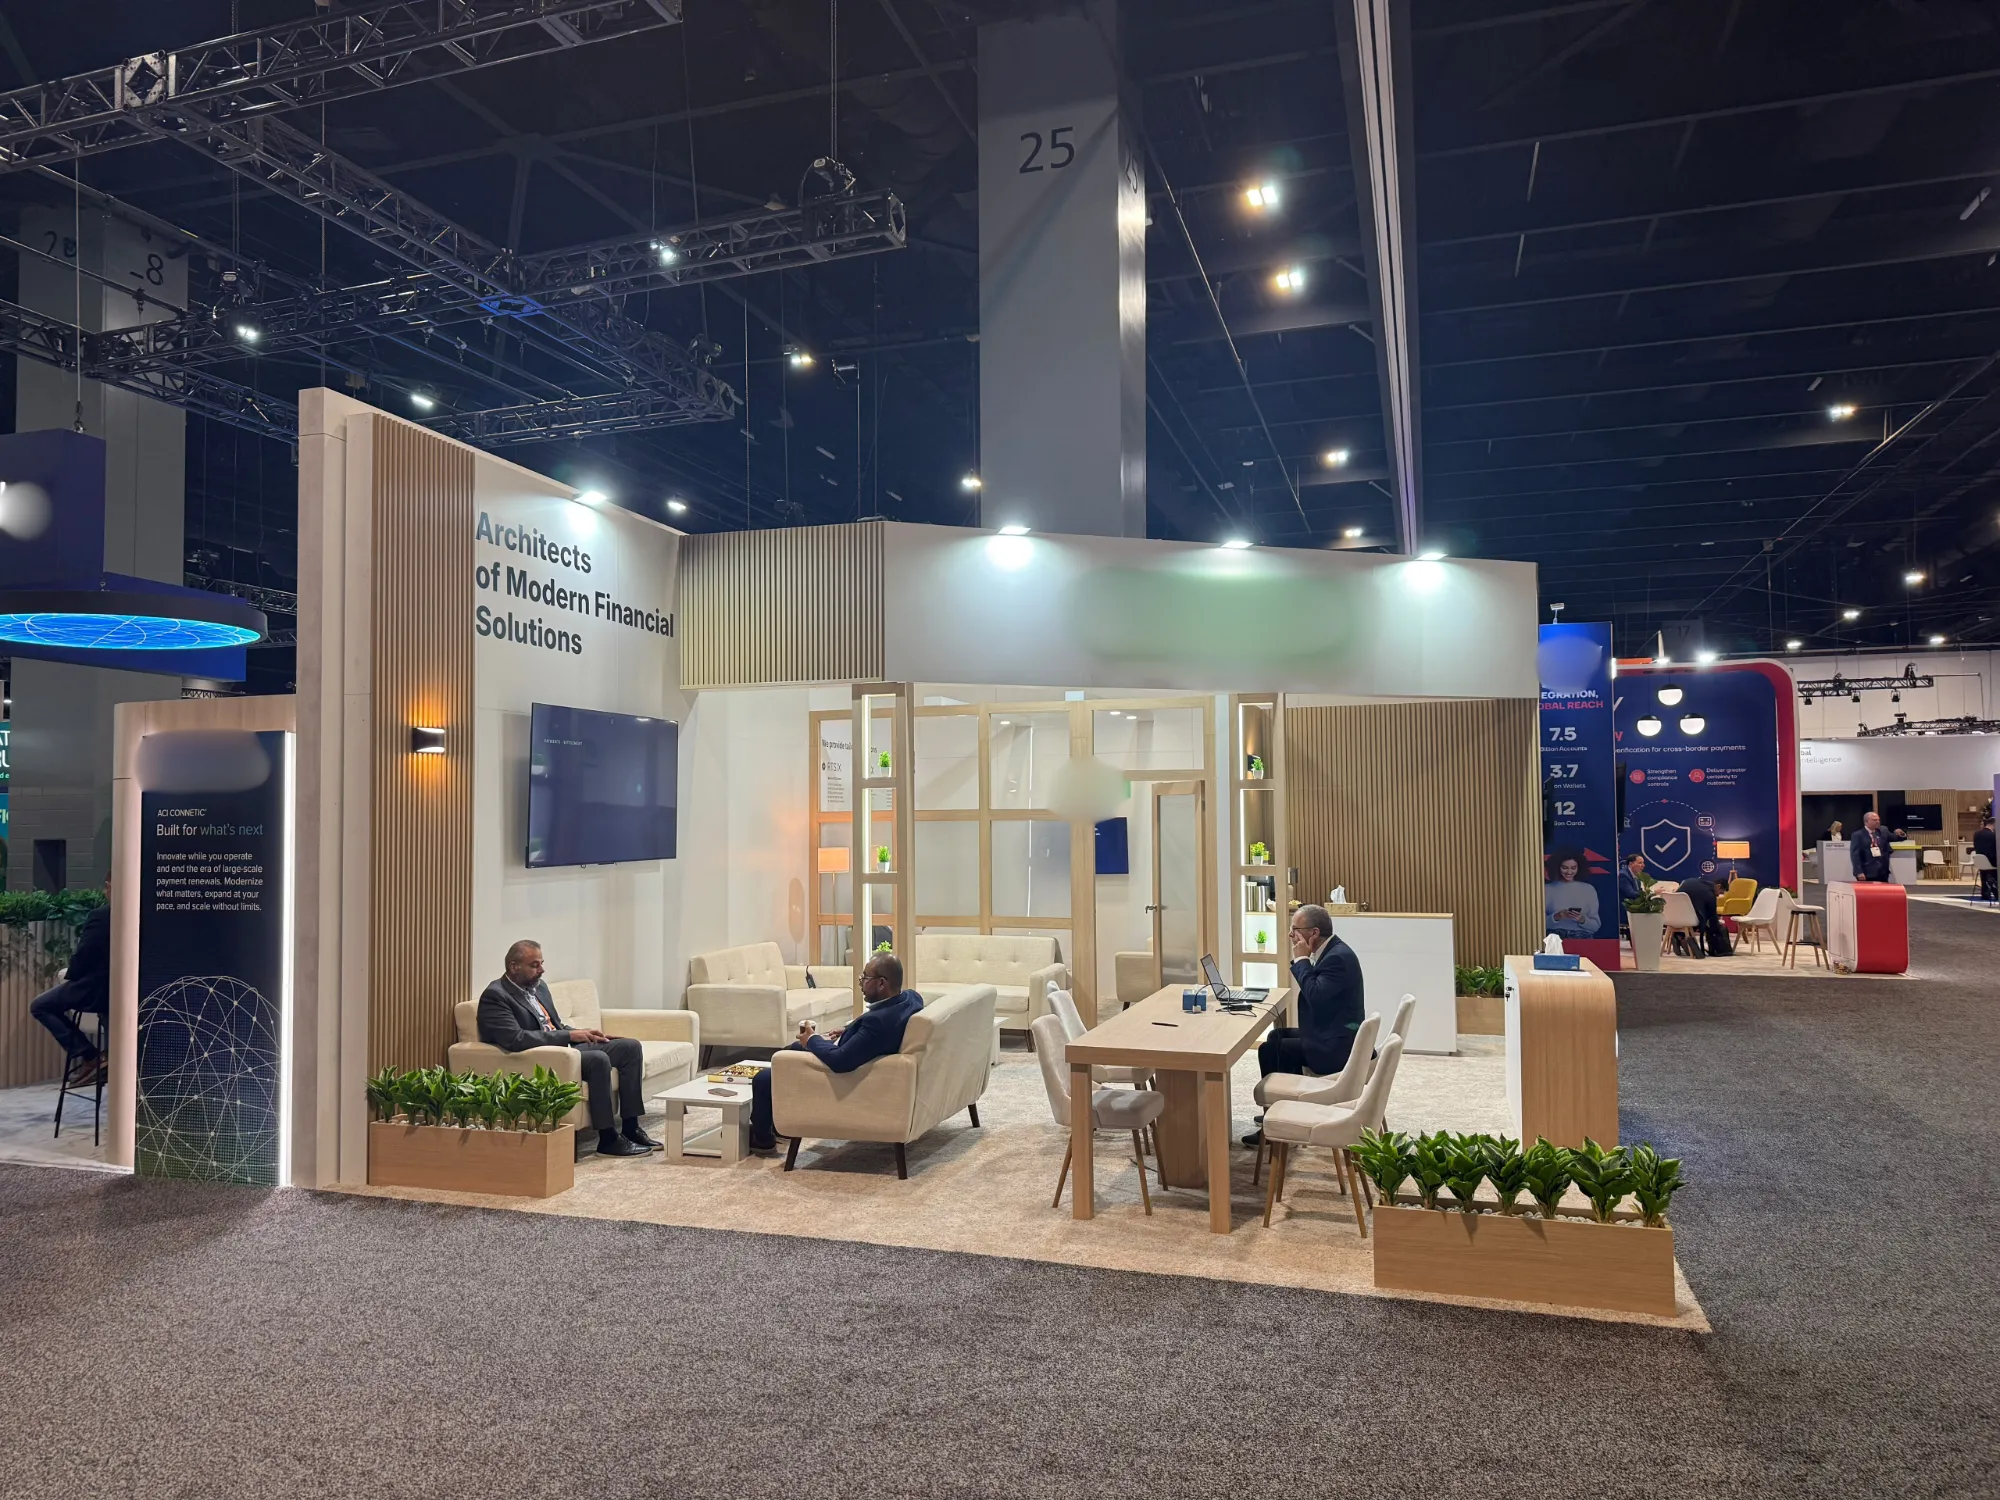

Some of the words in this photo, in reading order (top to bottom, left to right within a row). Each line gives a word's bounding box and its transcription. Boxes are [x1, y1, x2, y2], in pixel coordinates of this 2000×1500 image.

[1019, 126, 1075, 174] 25
[475, 511, 592, 574] Architects
[475, 561, 500, 592] of
[506, 565, 590, 615] Modern
[595, 590, 675, 638] Financial
[475, 605, 583, 655] Solutions
[1567, 701, 1604, 710] REACH
[1549, 726, 1577, 741] 7.5
[1710, 744, 1746, 752] payments
[1549, 764, 1579, 778] 3.7
[157, 809, 169, 817] ACI
[1554, 801, 1576, 815] 12
[156, 824, 180, 836] Built
[182, 823, 197, 836] for
[200, 823, 235, 836] what's
[238, 824, 264, 835] next
[156, 852, 187, 860] Innovate
[188, 852, 207, 860] while
[208, 854, 222, 862] you
[223, 852, 253, 861] operate
[156, 865, 170, 873] and
[171, 865, 185, 873] end
[186, 865, 198, 873] the
[213, 864, 221, 873] of
[222, 864, 263, 874] large-scale
[156, 878, 187, 887] payment
[188, 877, 222, 885] renewals.
[224, 877, 264, 886] Modernize
[156, 889, 173, 898] what
[174, 889, 203, 898] matters,
[204, 890, 232, 899] expand
[233, 890, 241, 898] at
[242, 891, 259, 900] your
[156, 903, 175, 912] pace,
[176, 902, 190, 910] and
[191, 902, 210, 910] scale
[212, 902, 239, 911] without
[240, 903, 262, 911] limits.
